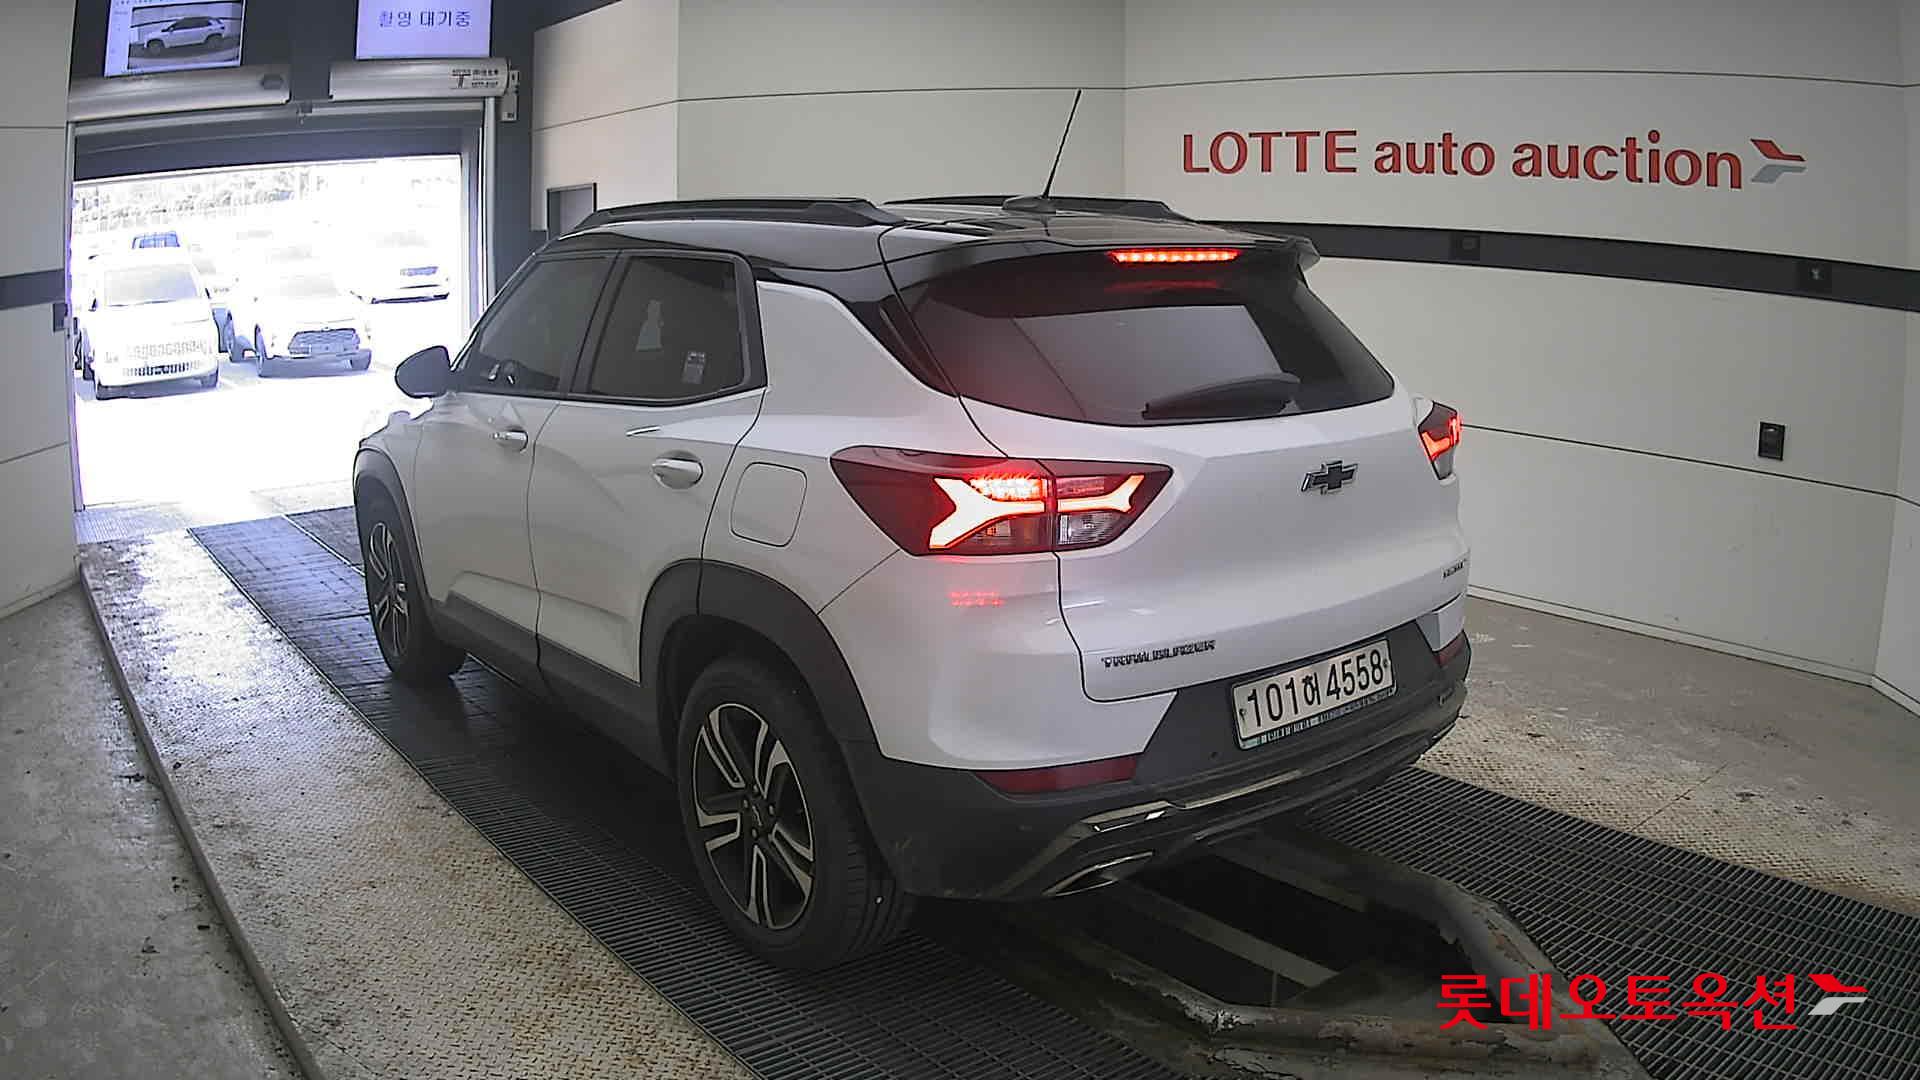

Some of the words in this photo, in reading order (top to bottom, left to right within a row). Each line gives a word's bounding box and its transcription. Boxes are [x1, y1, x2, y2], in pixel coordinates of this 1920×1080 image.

[420, 11, 471, 27] 대기중
[1183, 130, 1357, 175] LOTTE
[1374, 132, 1495, 176] auto
[1513, 130, 1742, 189] auction
